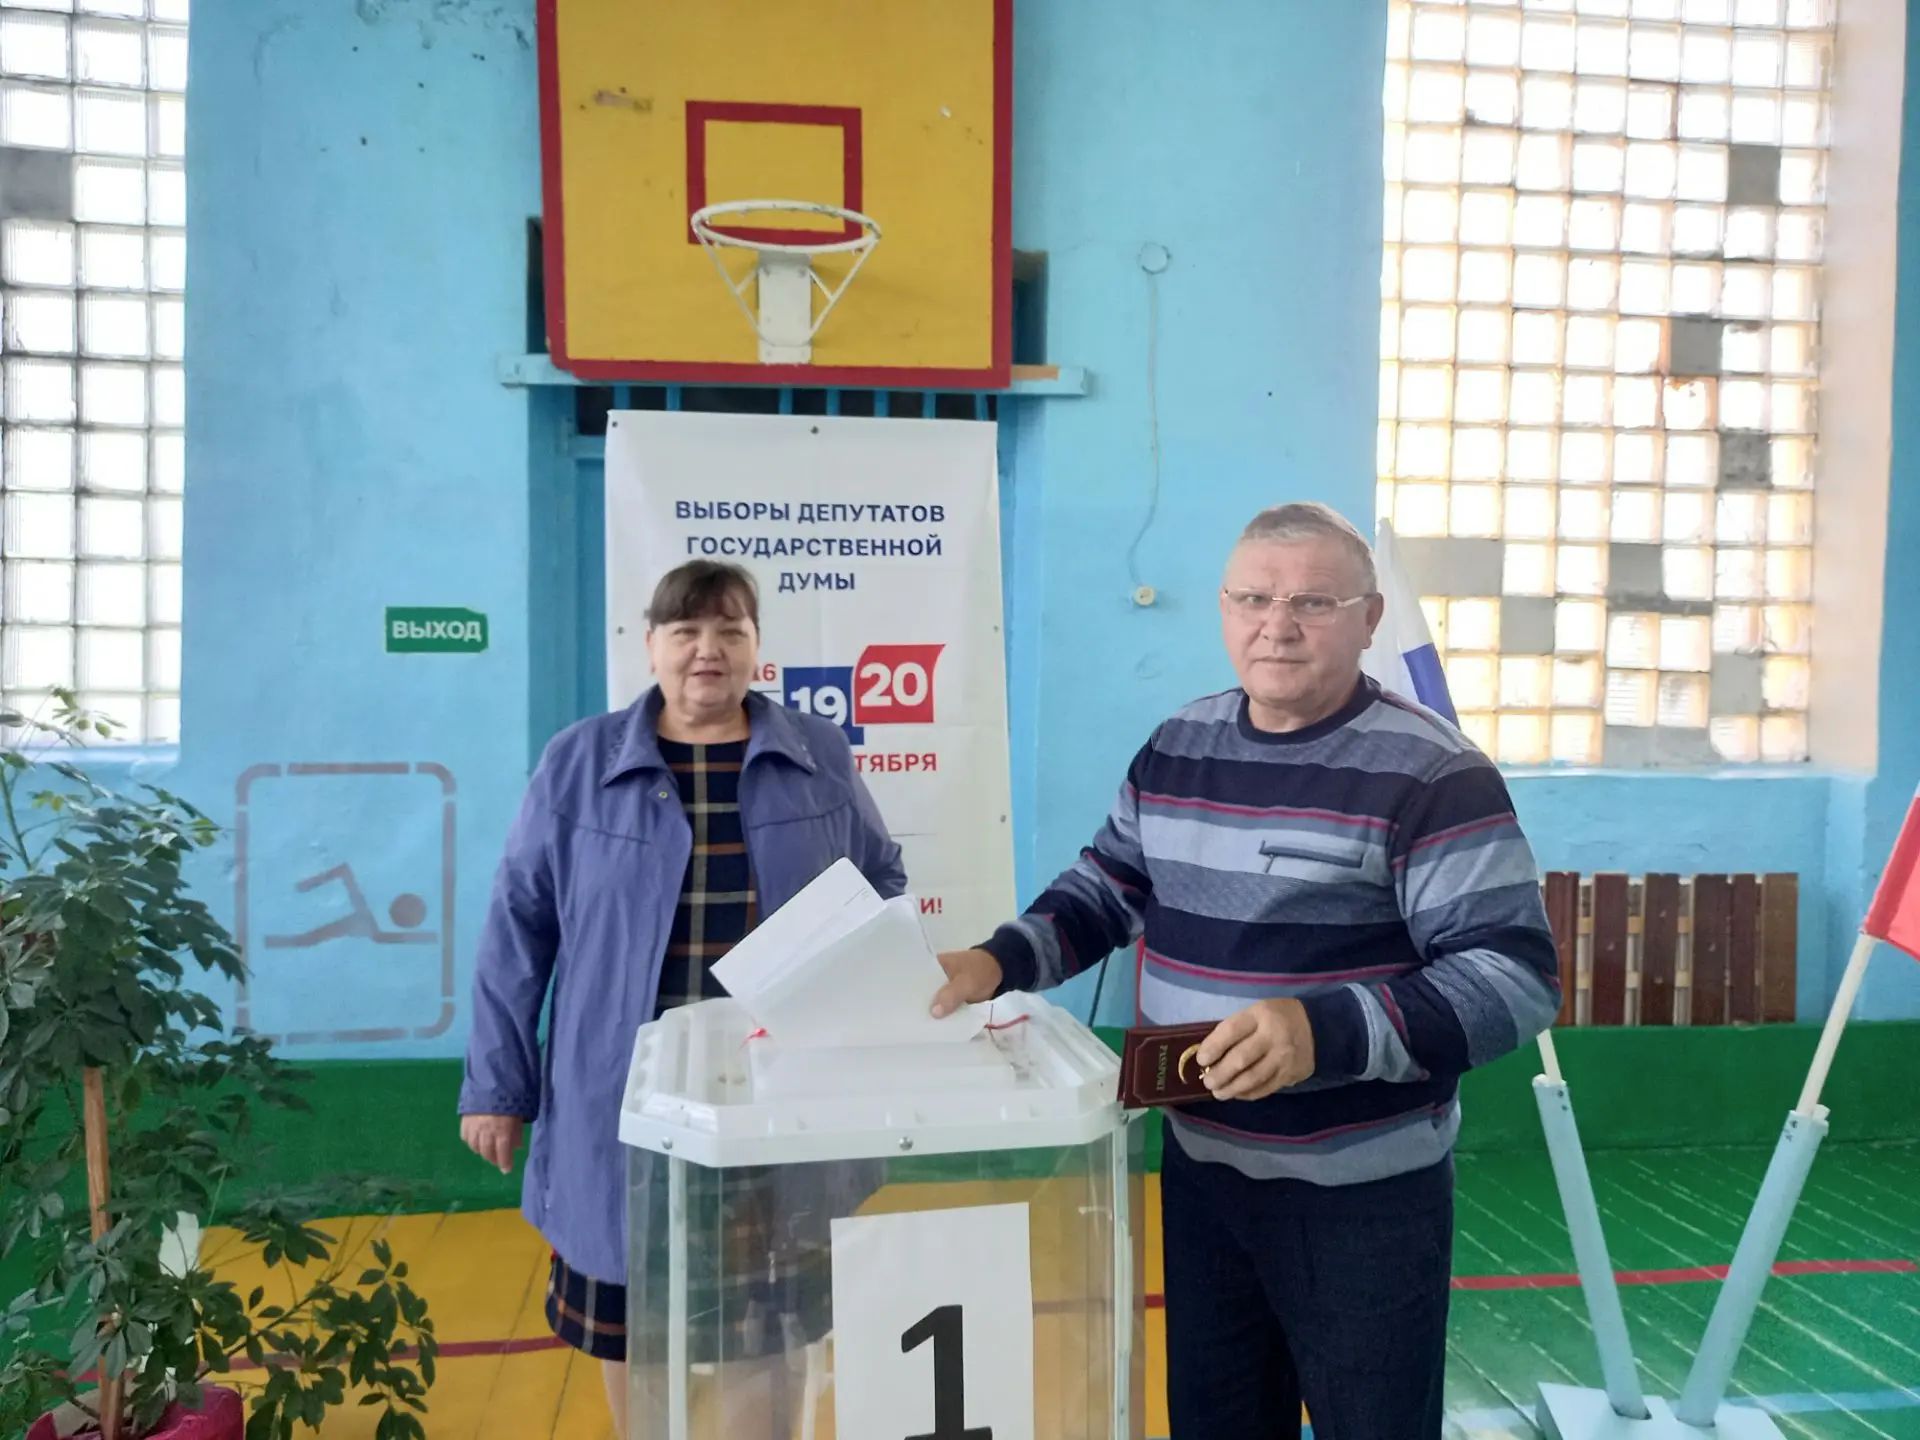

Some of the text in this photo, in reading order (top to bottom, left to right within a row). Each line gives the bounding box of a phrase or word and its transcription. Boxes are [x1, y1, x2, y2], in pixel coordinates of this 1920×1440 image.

[675, 500, 945, 524] ВЫБОРЫ ДЕПУТАТОВ
[686, 534, 942, 559] ГОСУДАРСТВЕННОЙ
[778, 572, 855, 593] ДУМЫ
[392, 621, 482, 642] ВЫХОД
[859, 661, 929, 708] 20
[790, 685, 848, 728] 19
[901, 1304, 993, 1440] 1
